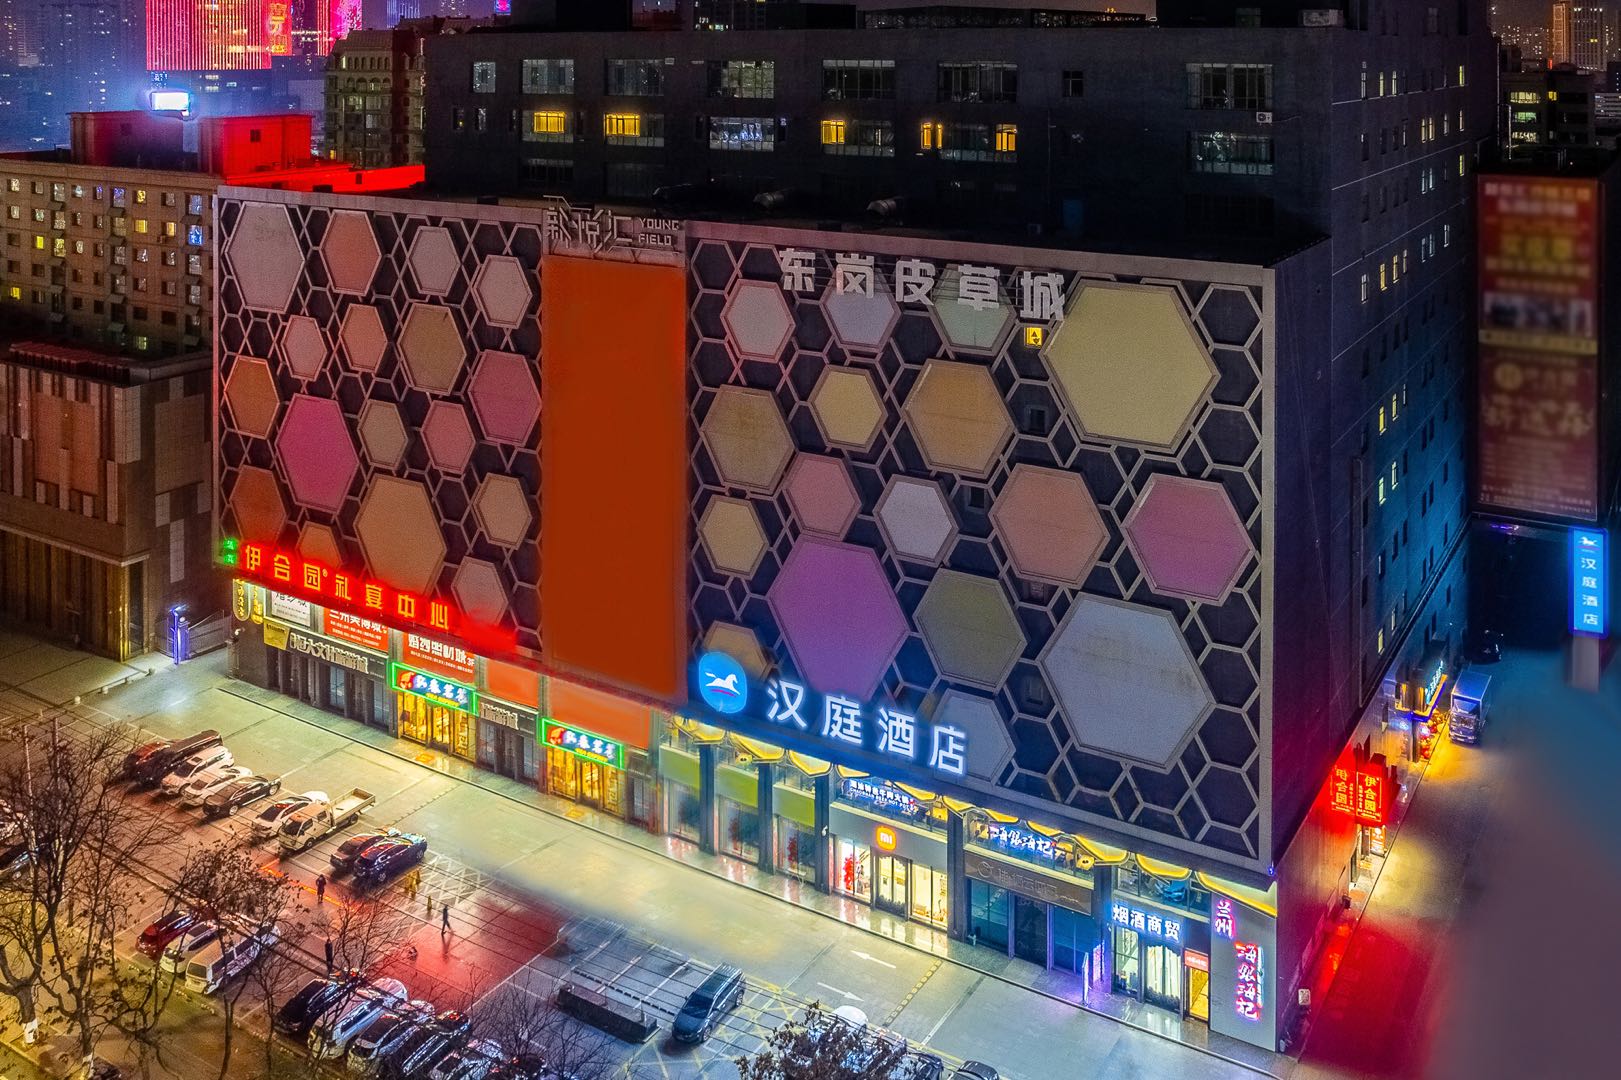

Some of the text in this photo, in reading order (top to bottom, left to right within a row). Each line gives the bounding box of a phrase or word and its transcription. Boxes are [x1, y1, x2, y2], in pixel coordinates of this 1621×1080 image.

[639, 217, 679, 231] YOUNG
[639, 233, 672, 246] FIELD
[778, 247, 1066, 321] 东岗皮草城
[1580, 557, 1599, 626] 汉庭酒店
[766, 677, 967, 776] 汉庭酒店
[1112, 904, 1180, 941] 烟酒商贸
[1215, 900, 1233, 938] 兰州
[1235, 942, 1258, 1020] 海银海记
